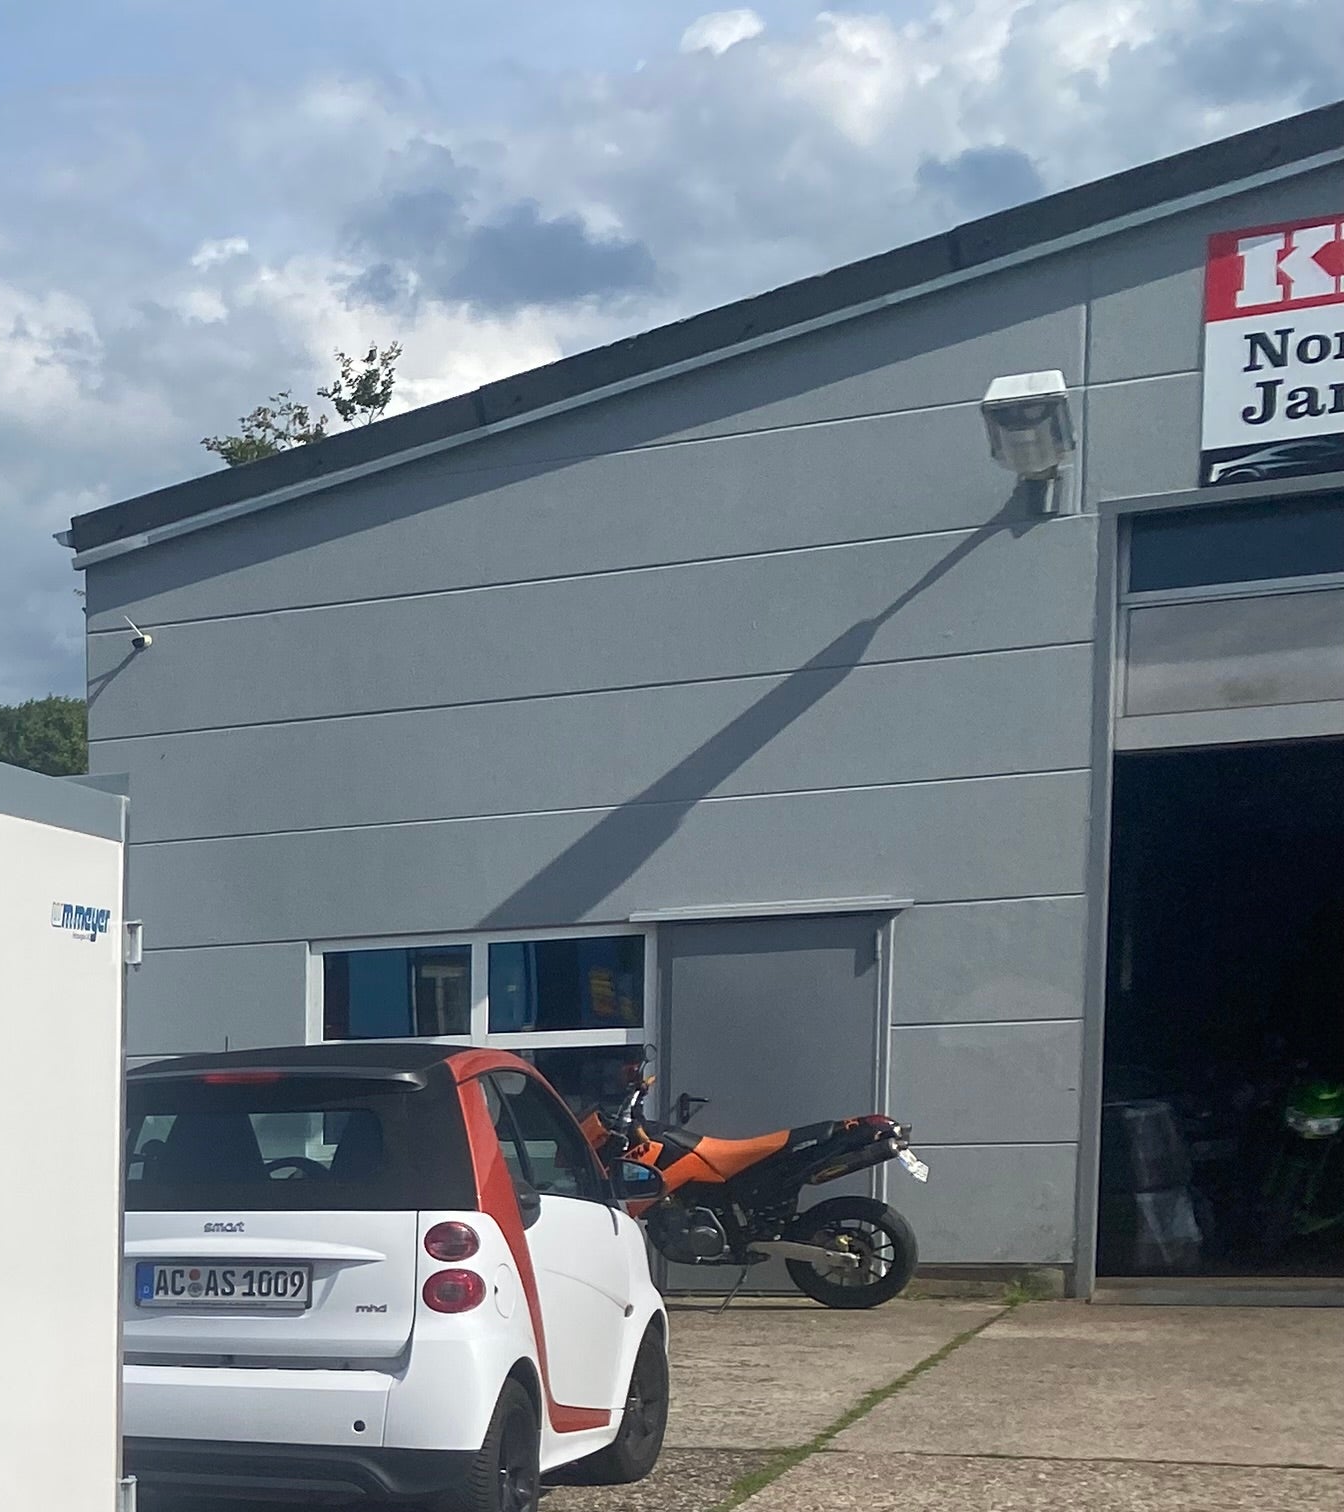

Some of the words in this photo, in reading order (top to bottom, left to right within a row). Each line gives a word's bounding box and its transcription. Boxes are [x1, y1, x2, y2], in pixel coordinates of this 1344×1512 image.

[1236, 222, 1344, 308] K
[204, 1221, 245, 1233] smart
[155, 1269, 185, 1296] AC
[205, 1270, 236, 1297] AS
[242, 1270, 305, 1297] 1009
[355, 1304, 387, 1313] mhd
